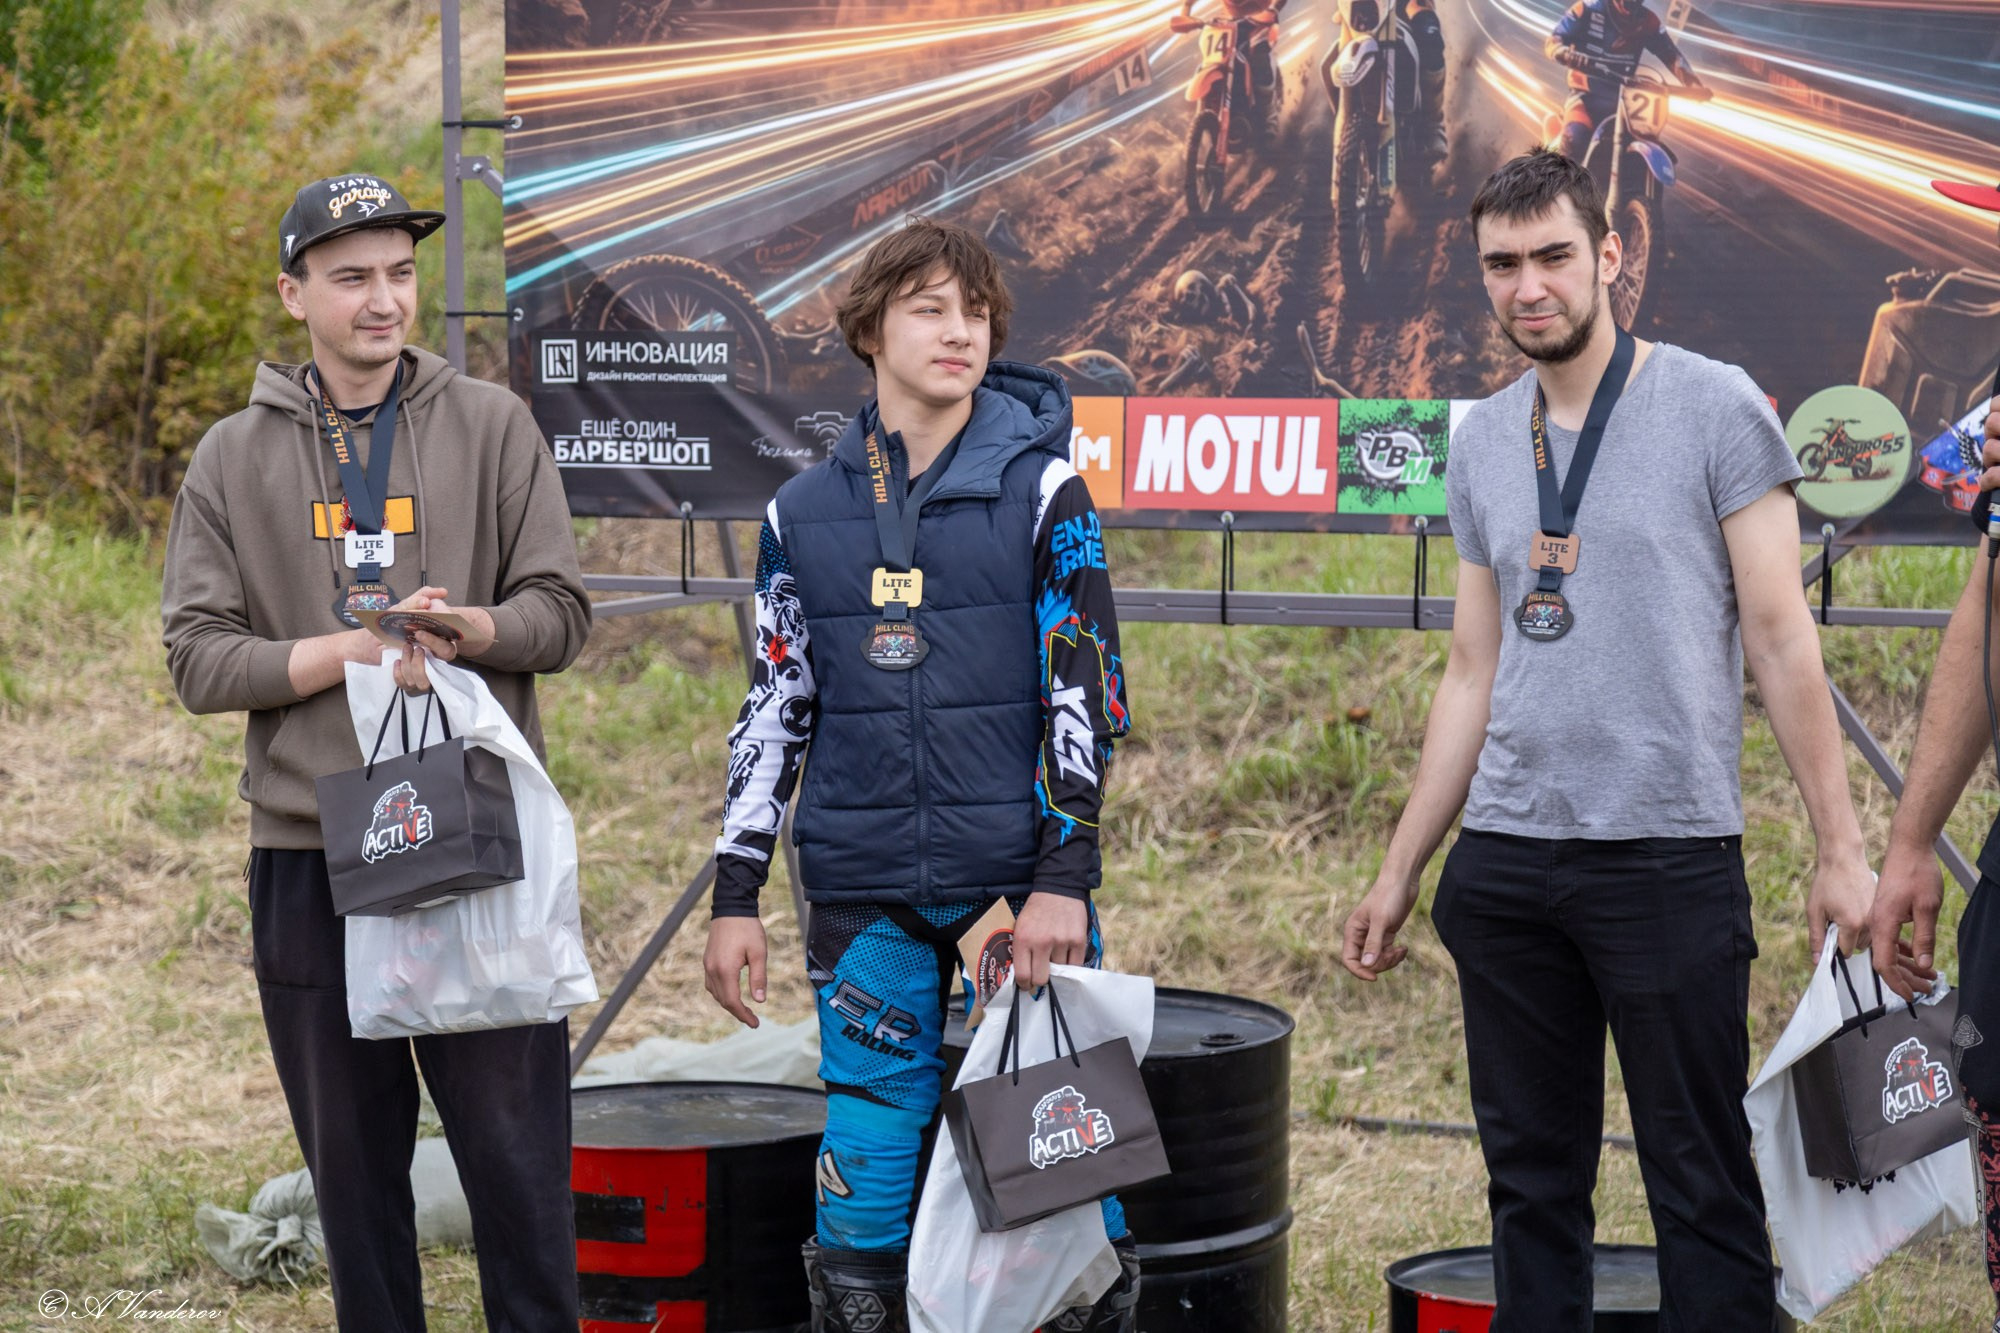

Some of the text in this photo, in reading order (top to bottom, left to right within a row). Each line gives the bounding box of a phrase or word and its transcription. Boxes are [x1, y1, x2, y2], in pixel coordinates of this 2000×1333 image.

[1206, 32, 1229, 57] 14
[1119, 54, 1146, 89] 14
[1630, 93, 1661, 126] 21
[329, 177, 380, 192] STAY IN
[328, 186, 392, 219] garage
[585, 341, 728, 366] ИННОВАЦИЯ
[587, 370, 728, 383] ДИЗАЙН РЕМОНТ КОМПЛЕКТАЦИЯ
[581, 418, 676, 441] ЕЩЁ ОДИН
[332, 428, 350, 464] HILL
[554, 440, 711, 465] БАРБЕРШОП
[865, 431, 883, 469] CLIM
[1068, 426, 1112, 471] TM
[1133, 413, 1328, 497] MOTUL
[1534, 432, 1547, 470] HILL
[872, 470, 888, 503] HILL
[354, 539, 384, 550] LITE
[363, 550, 375, 561] 2
[1541, 541, 1569, 554] LITE
[1547, 553, 1558, 564] 3
[348, 584, 388, 595] HILL CLIMB
[882, 578, 912, 588] LITE
[893, 588, 900, 599] 1
[875, 624, 915, 635] HILL CLIMB
[364, 809, 429, 856] ACTIVE
[1885, 1068, 1949, 1117] ACTIVE
[1033, 1114, 1112, 1161] ACTIVE
